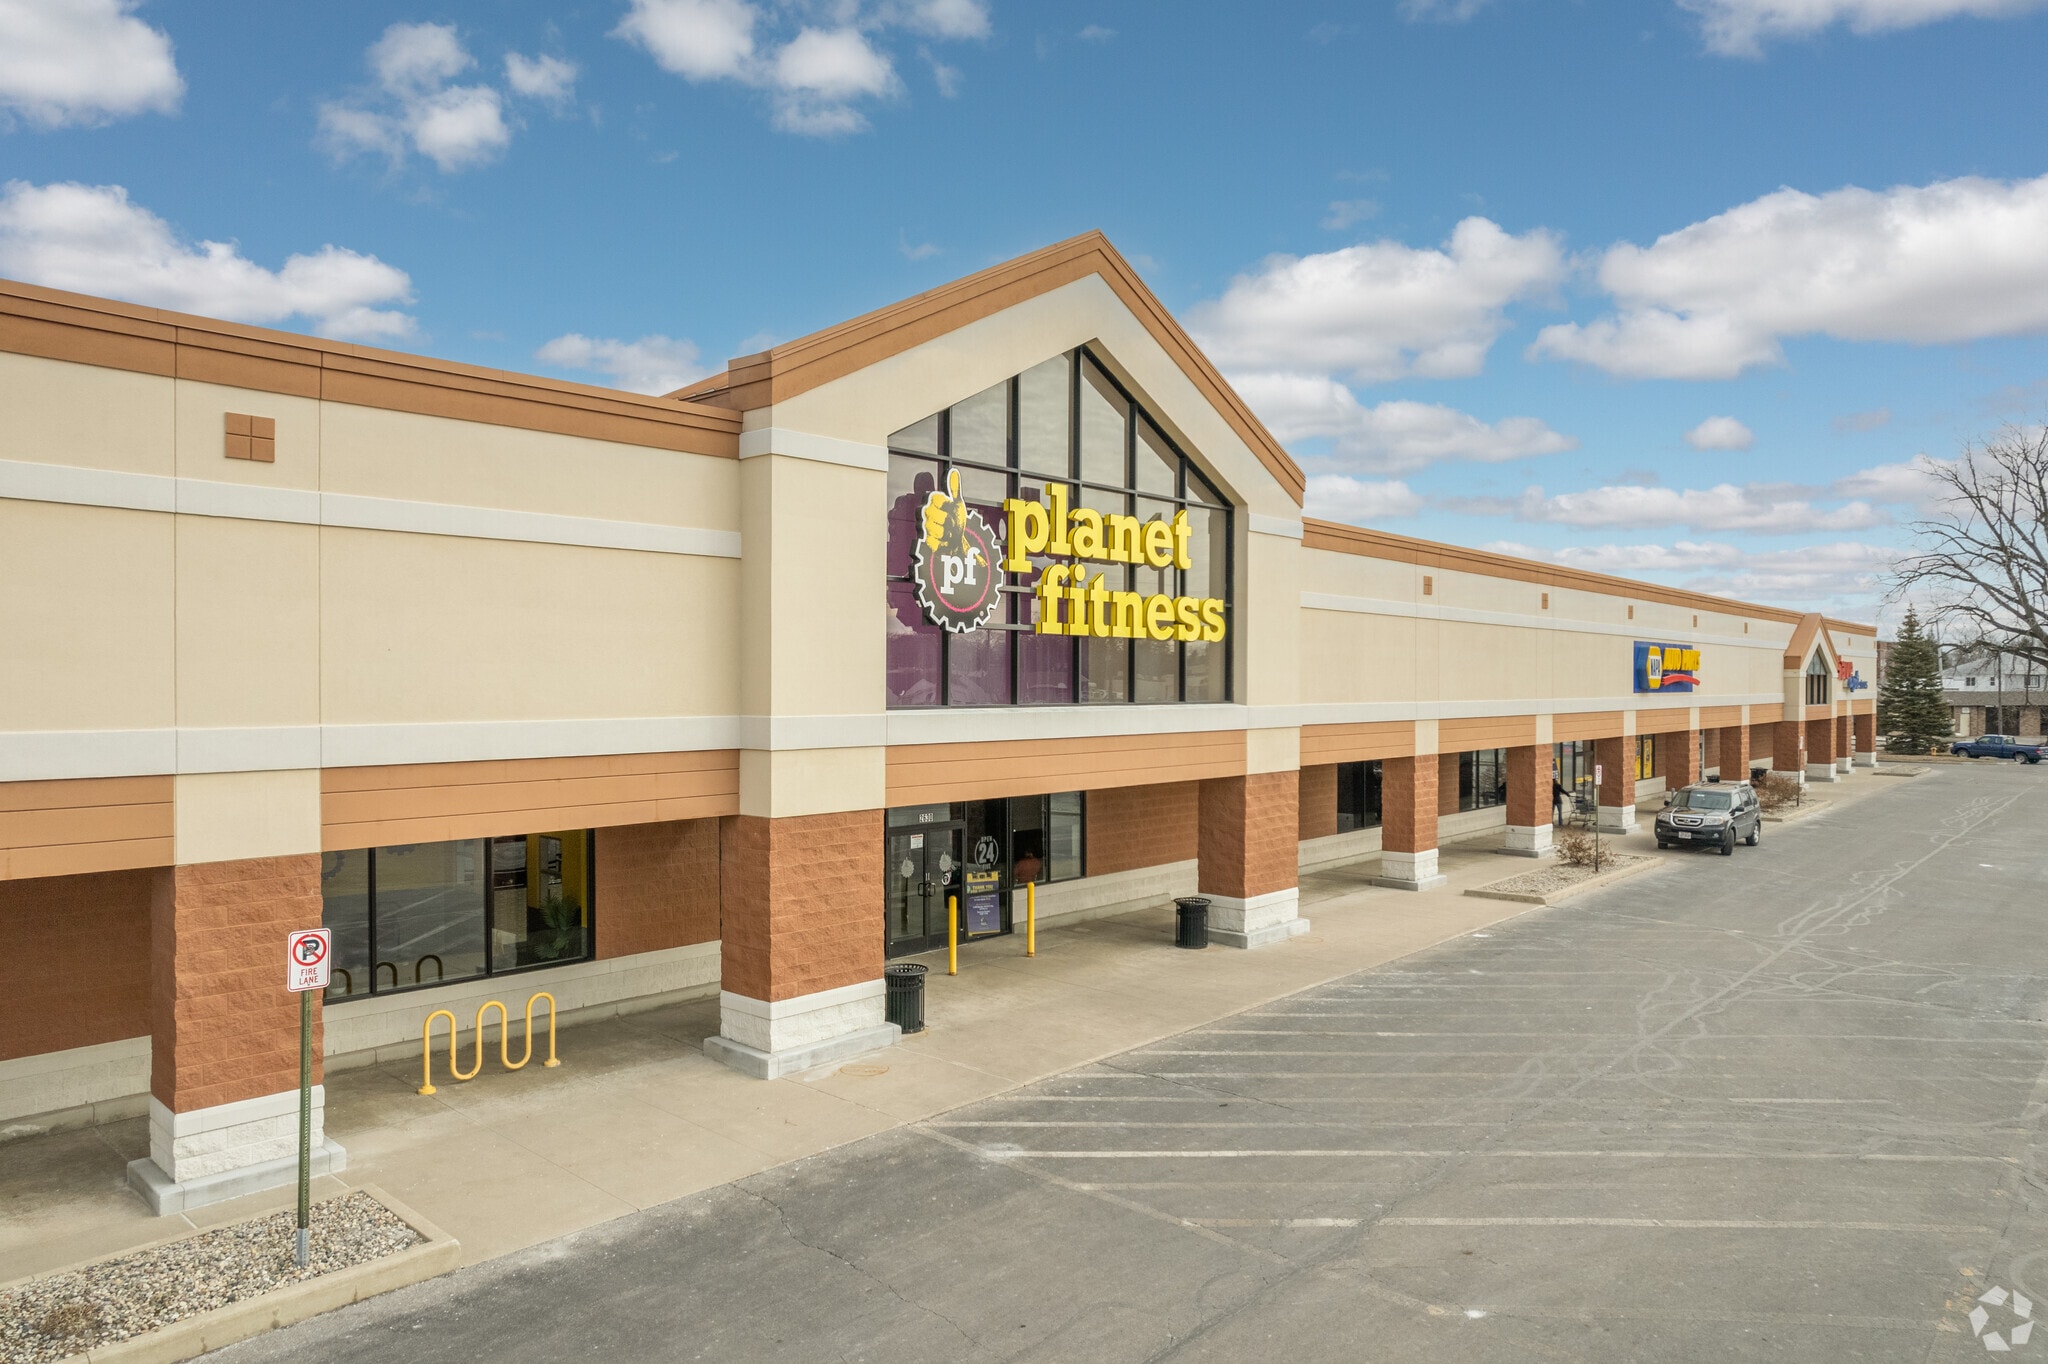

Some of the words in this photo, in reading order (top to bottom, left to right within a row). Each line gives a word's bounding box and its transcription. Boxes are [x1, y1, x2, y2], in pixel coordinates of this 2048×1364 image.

[1003, 483, 1192, 573] planet
[940, 546, 981, 595] pf
[1035, 563, 1226, 643] fitness
[978, 842, 995, 864] 24
[302, 939, 320, 960] P
[299, 976, 319, 985] LANE
[301, 967, 318, 976] FIRE
